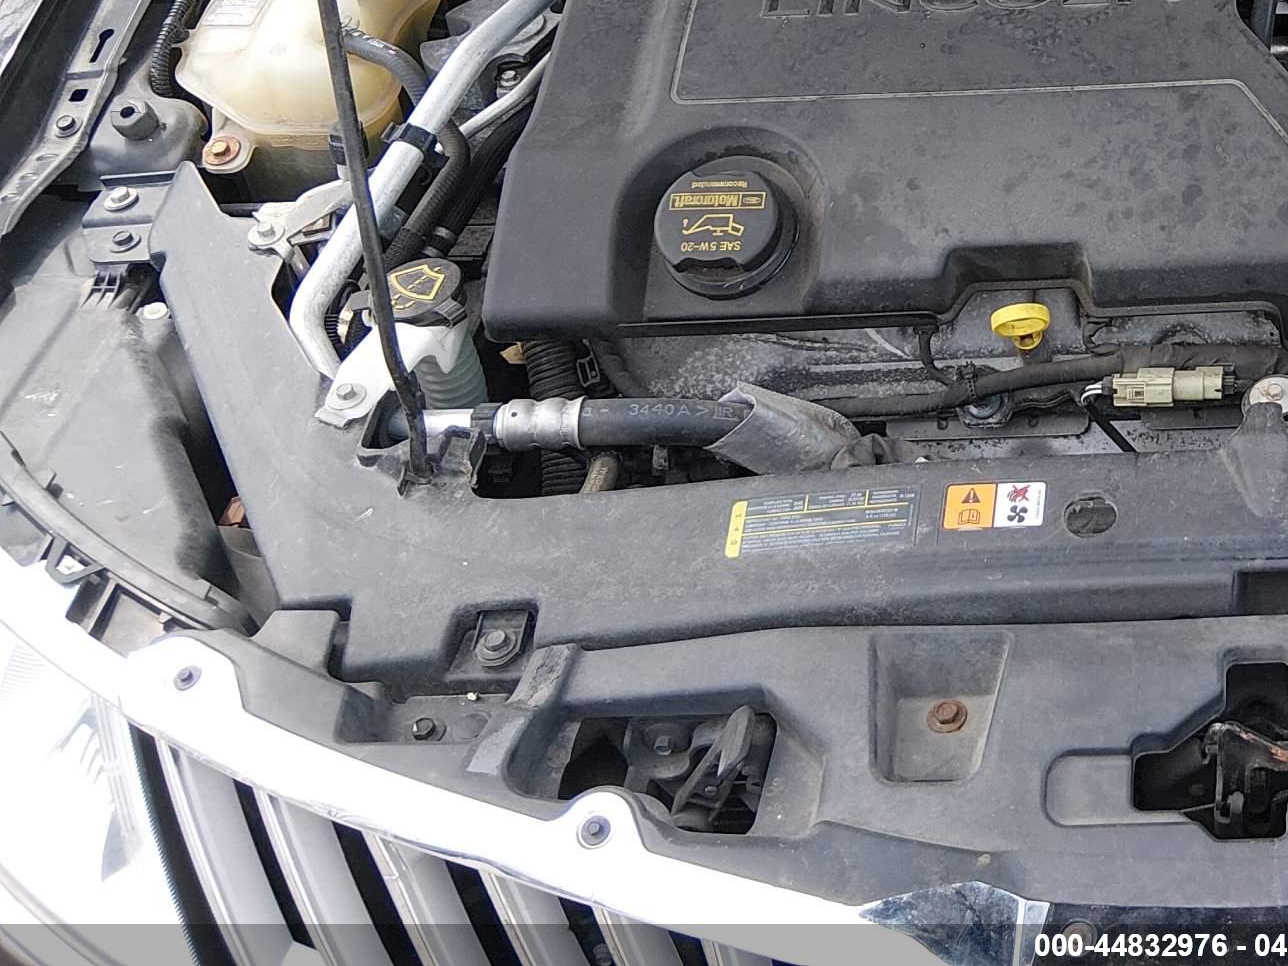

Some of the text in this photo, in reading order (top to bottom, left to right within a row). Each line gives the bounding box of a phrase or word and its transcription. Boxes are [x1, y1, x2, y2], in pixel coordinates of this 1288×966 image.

[691, 181, 748, 189] Recommended
[673, 195, 738, 207] Motorcraft
[719, 241, 742, 251] SAE
